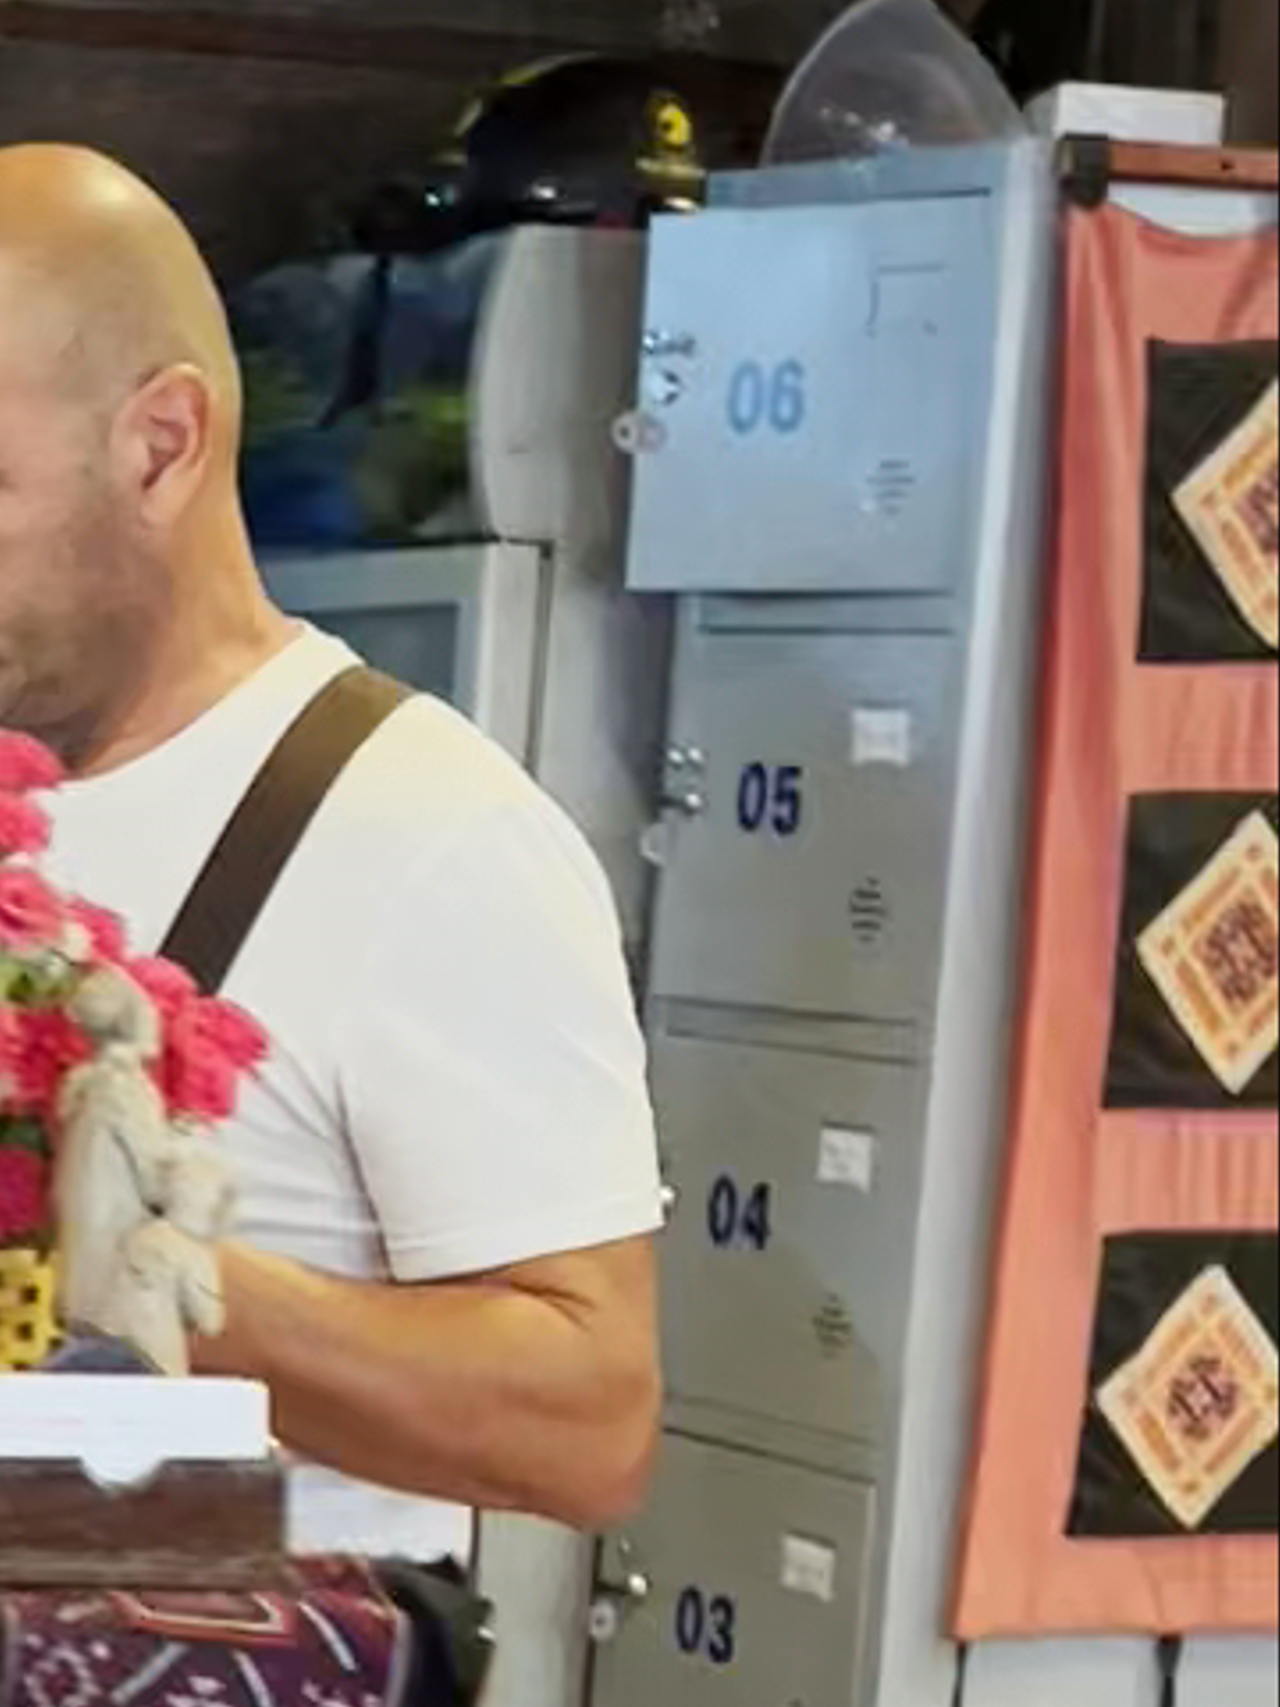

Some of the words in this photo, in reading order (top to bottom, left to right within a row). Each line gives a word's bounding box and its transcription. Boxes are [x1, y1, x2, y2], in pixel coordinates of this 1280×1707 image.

[726, 357, 806, 435] 06
[736, 761, 803, 836] 05
[707, 1173, 772, 1251] 04
[674, 1586, 736, 1665] 03
